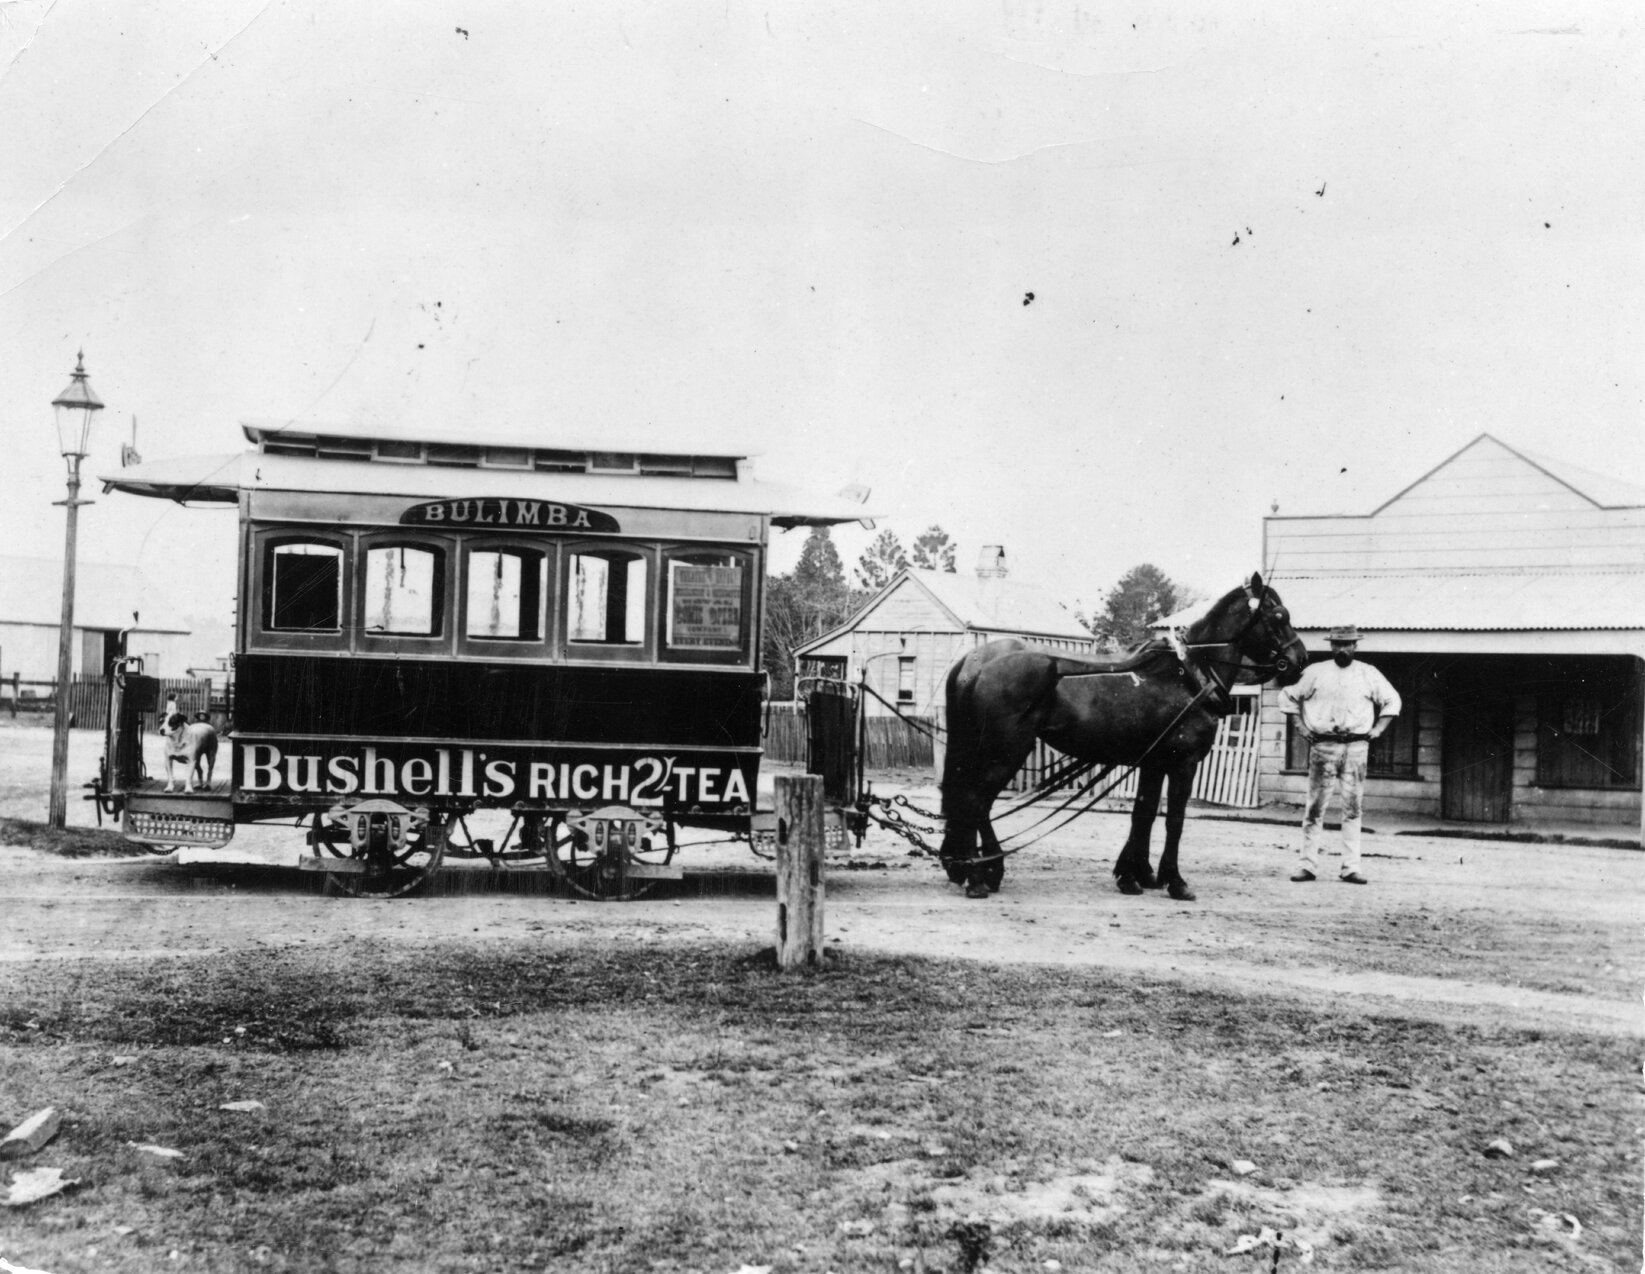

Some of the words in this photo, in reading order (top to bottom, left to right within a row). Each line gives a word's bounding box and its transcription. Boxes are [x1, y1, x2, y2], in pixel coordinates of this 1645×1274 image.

[424, 500, 592, 527] BULIMBA
[239, 743, 516, 798] Bushell's
[529, 762, 630, 800] RICH
[672, 767, 750, 802] TEA
